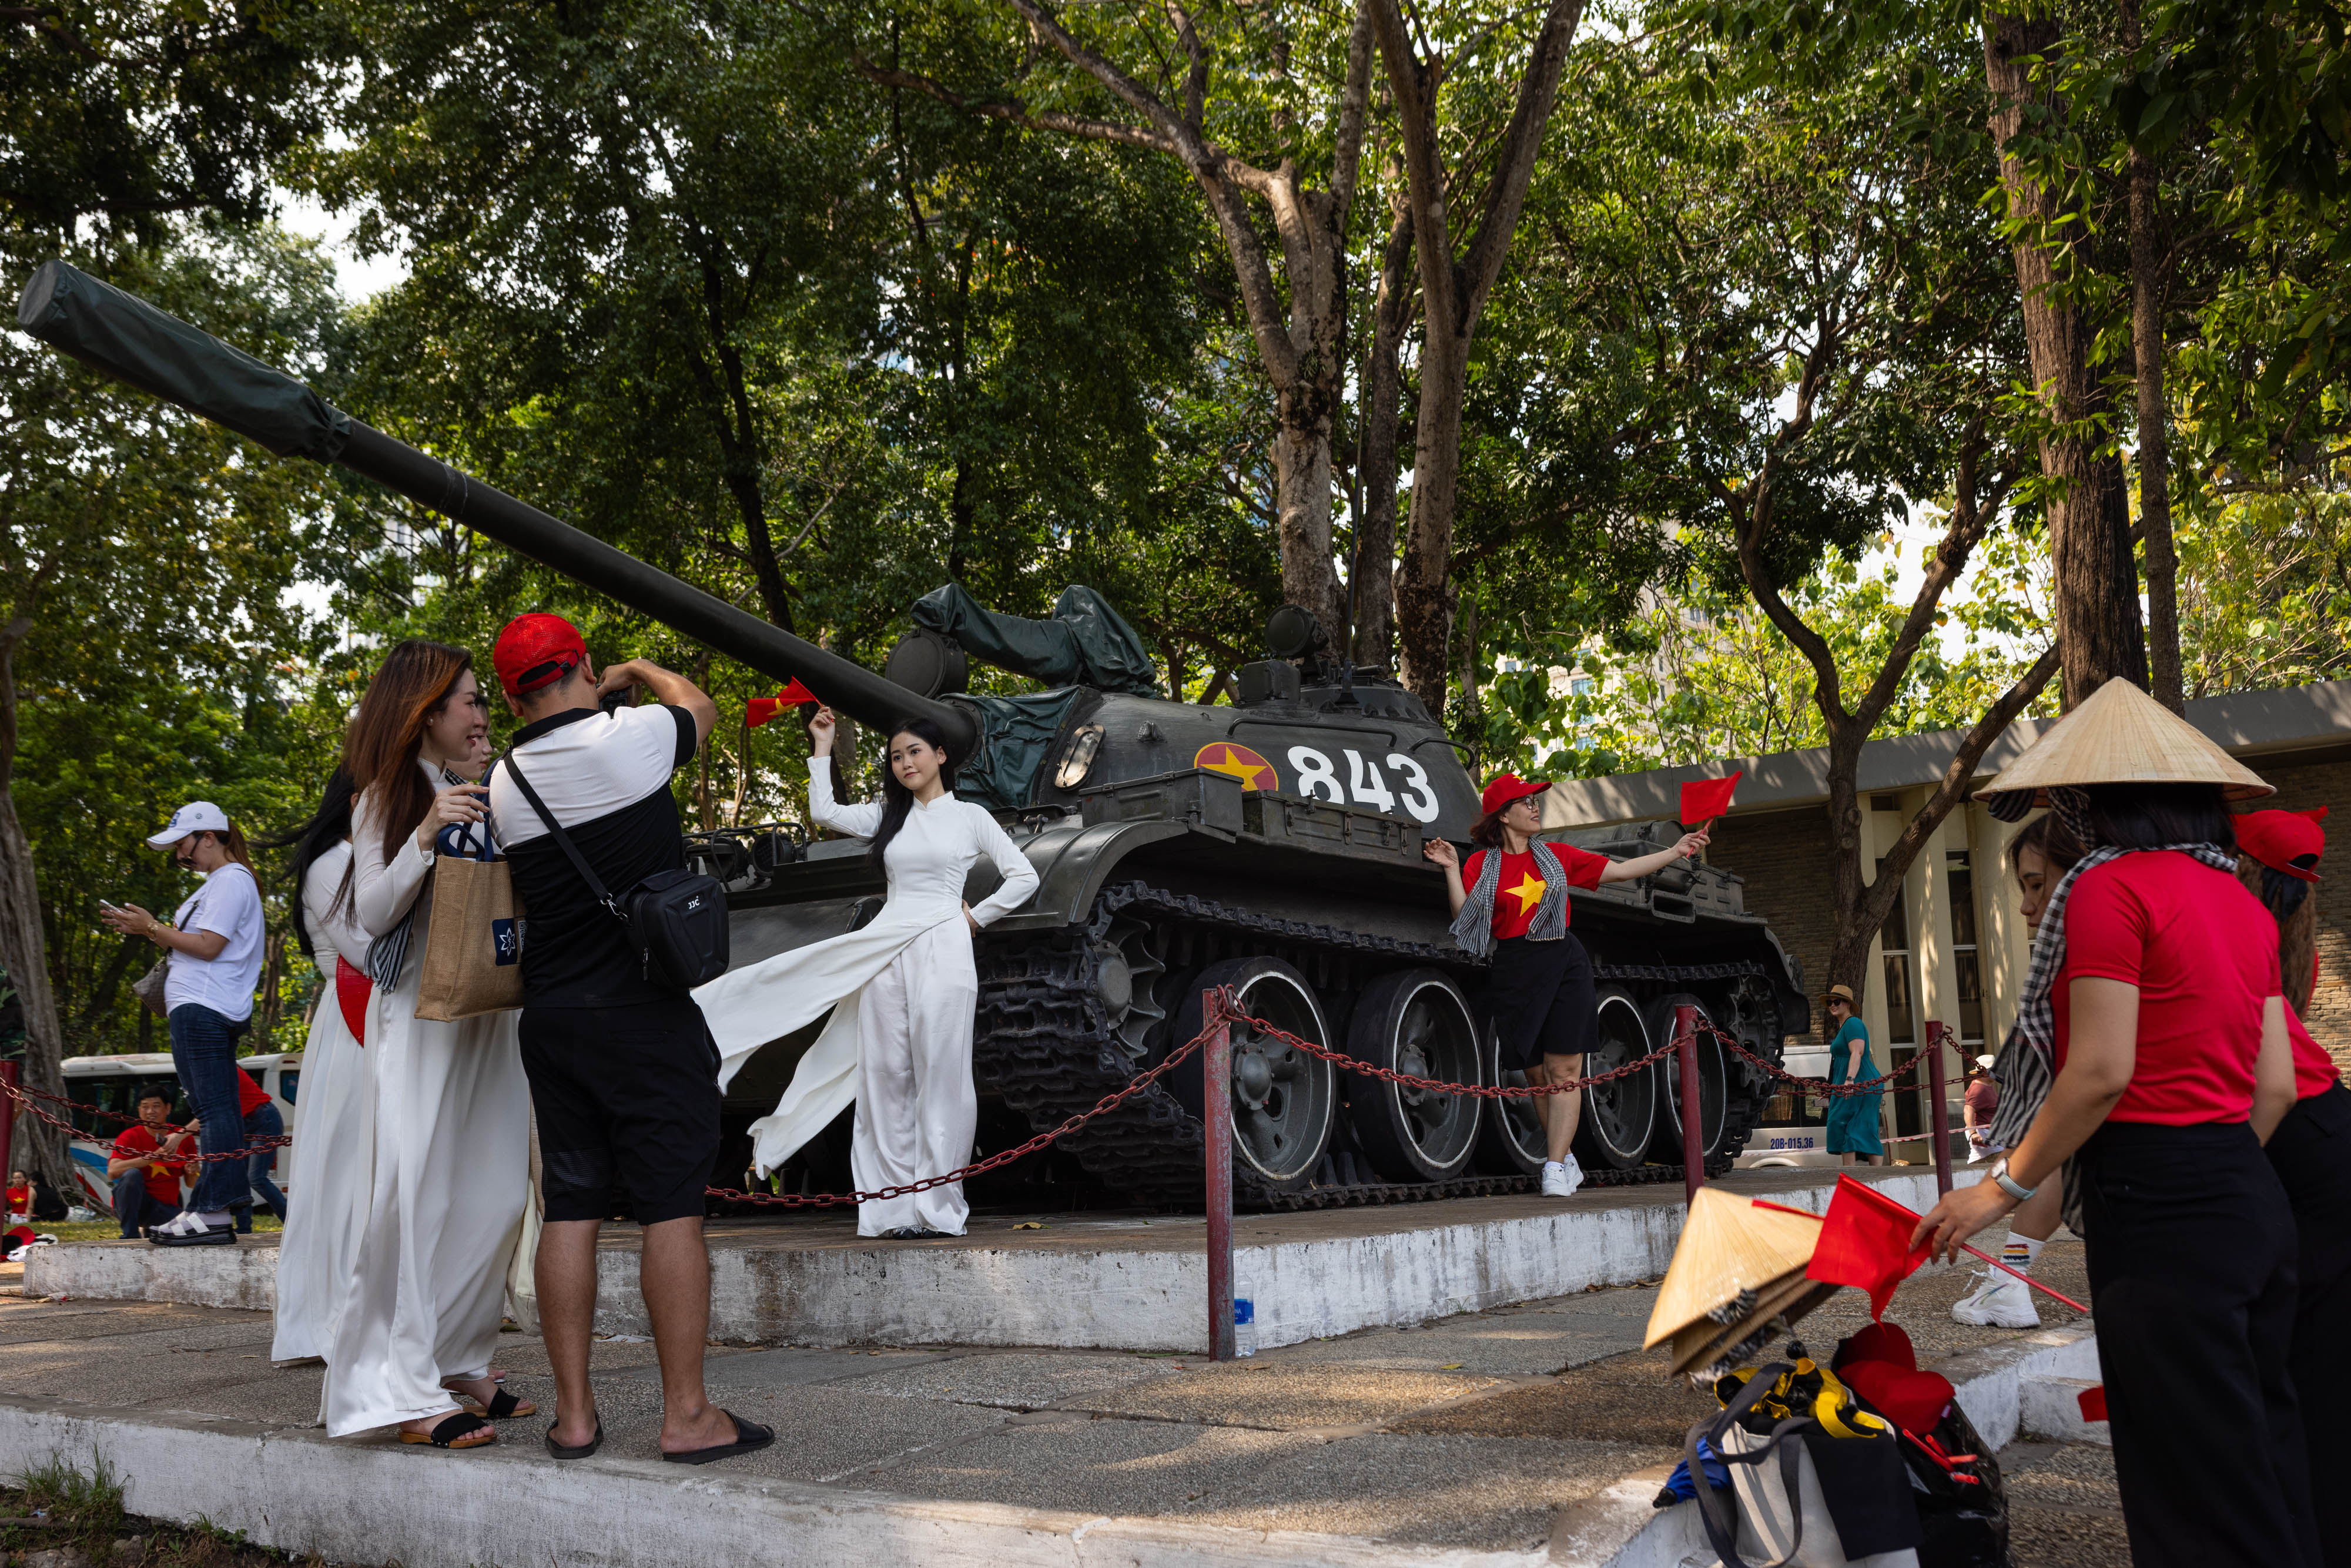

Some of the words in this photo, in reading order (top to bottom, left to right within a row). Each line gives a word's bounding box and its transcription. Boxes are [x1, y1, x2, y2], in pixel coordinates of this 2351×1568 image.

[1288, 746, 1439, 823] 843
[688, 899, 700, 909] JJC
[1770, 1137, 1813, 1150] 20B-015.36
